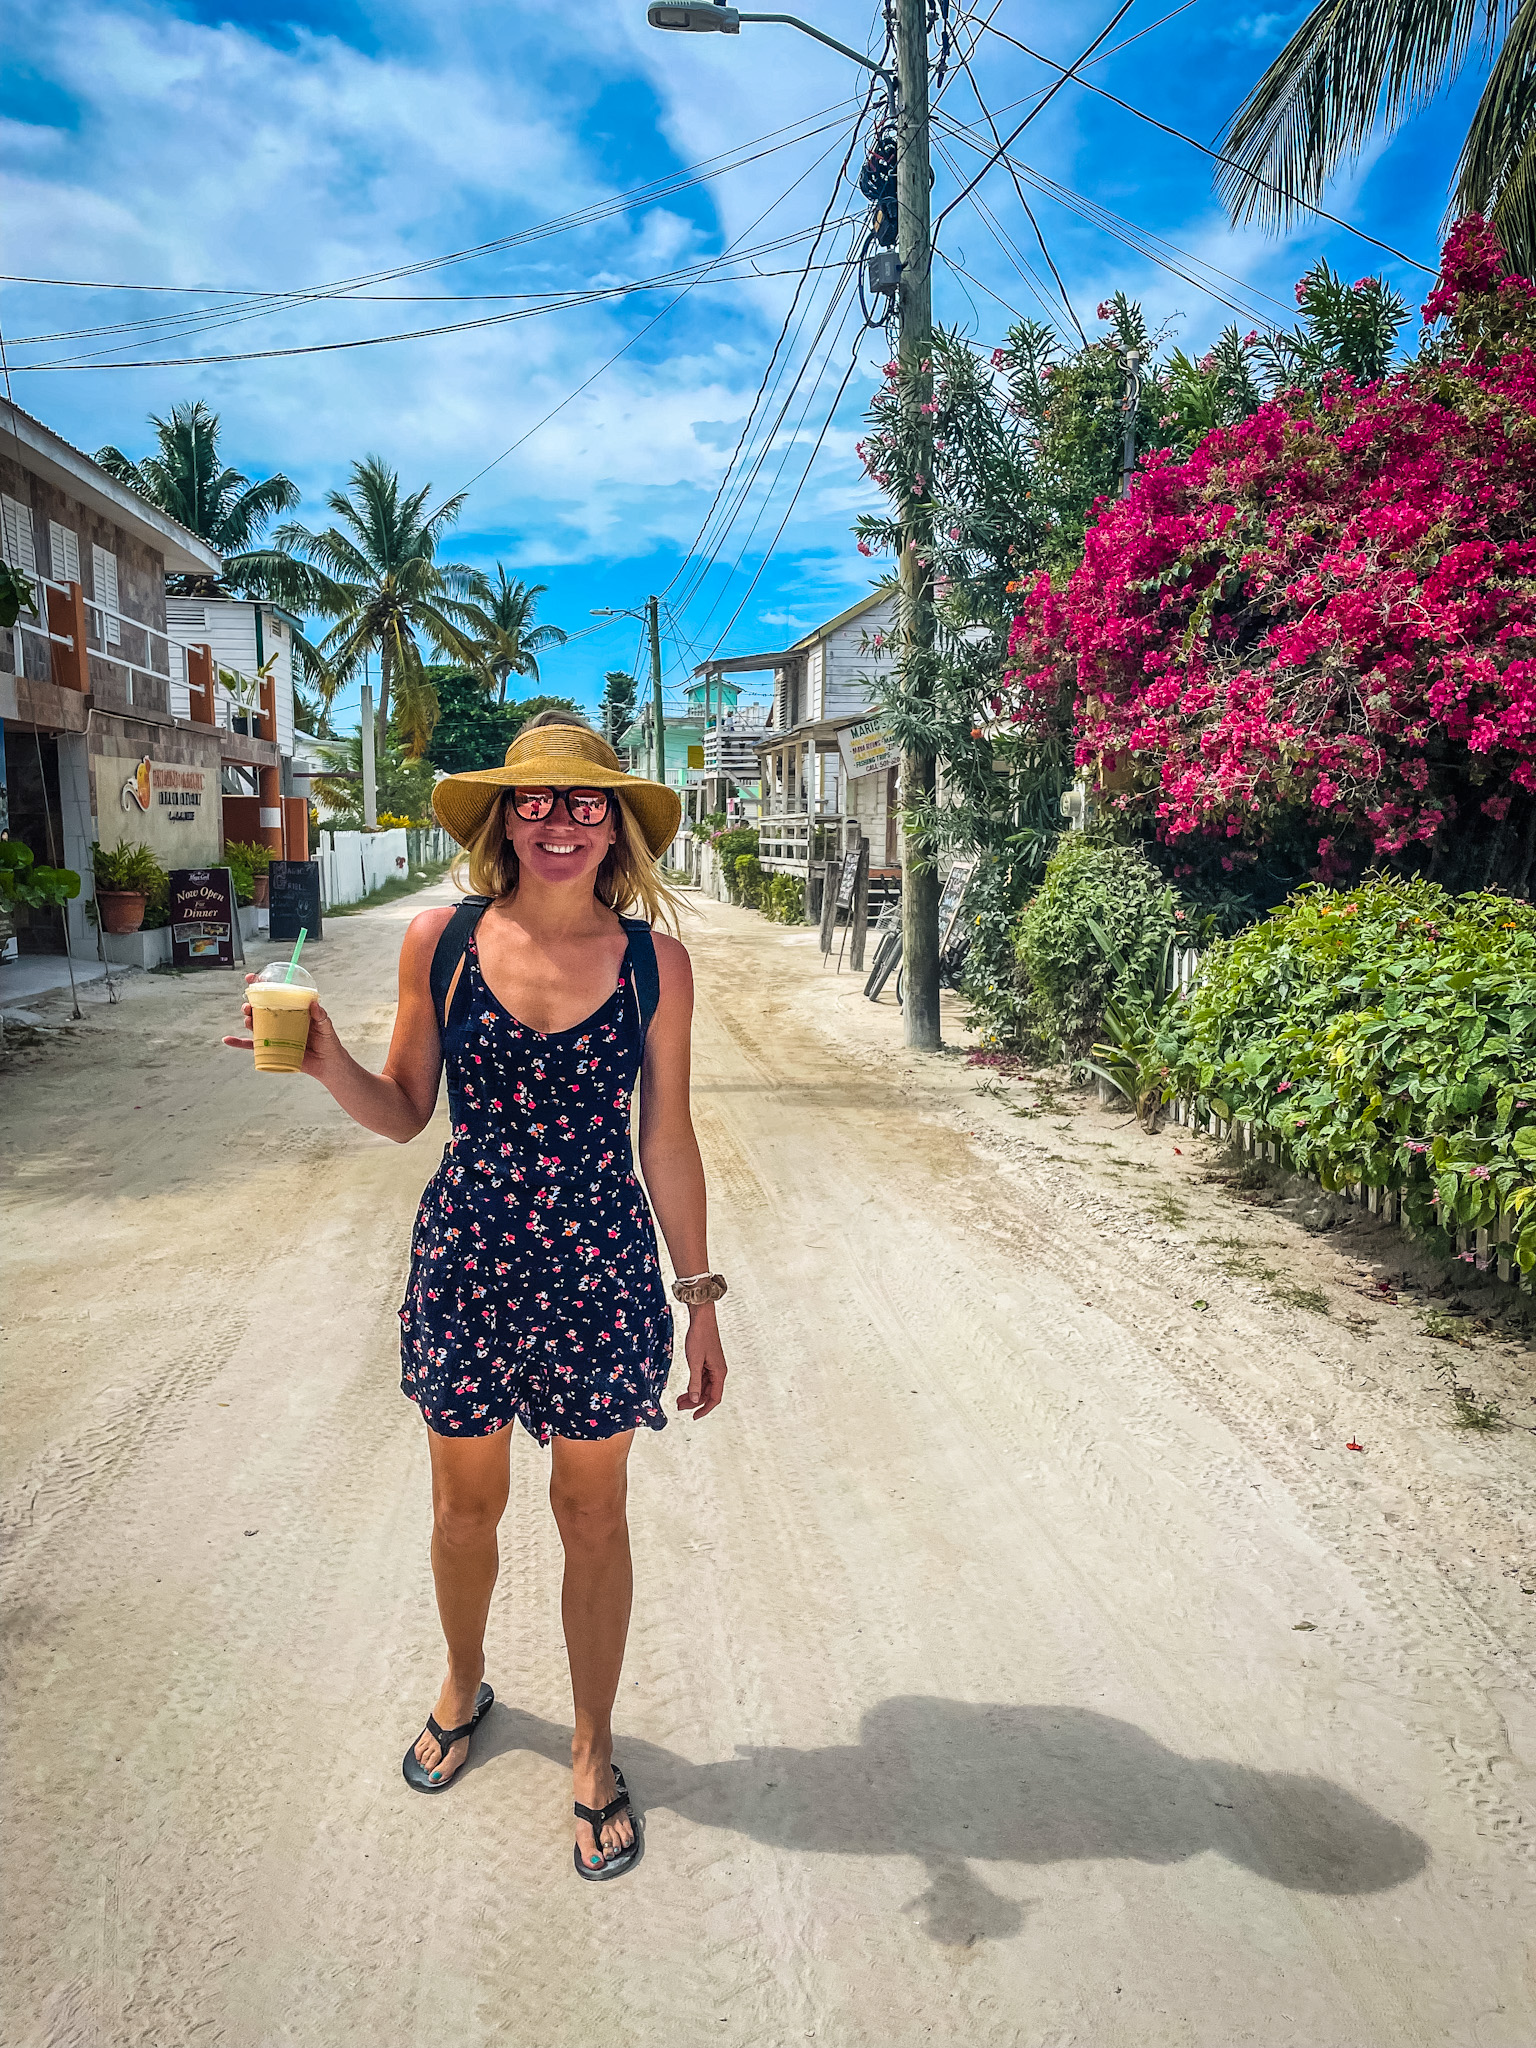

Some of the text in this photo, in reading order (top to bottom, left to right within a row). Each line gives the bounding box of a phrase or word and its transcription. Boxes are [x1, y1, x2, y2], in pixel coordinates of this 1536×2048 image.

[866, 763, 879, 772] CALL
[177, 886, 225, 904] Now Open
[183, 908, 219, 918] Dinner
